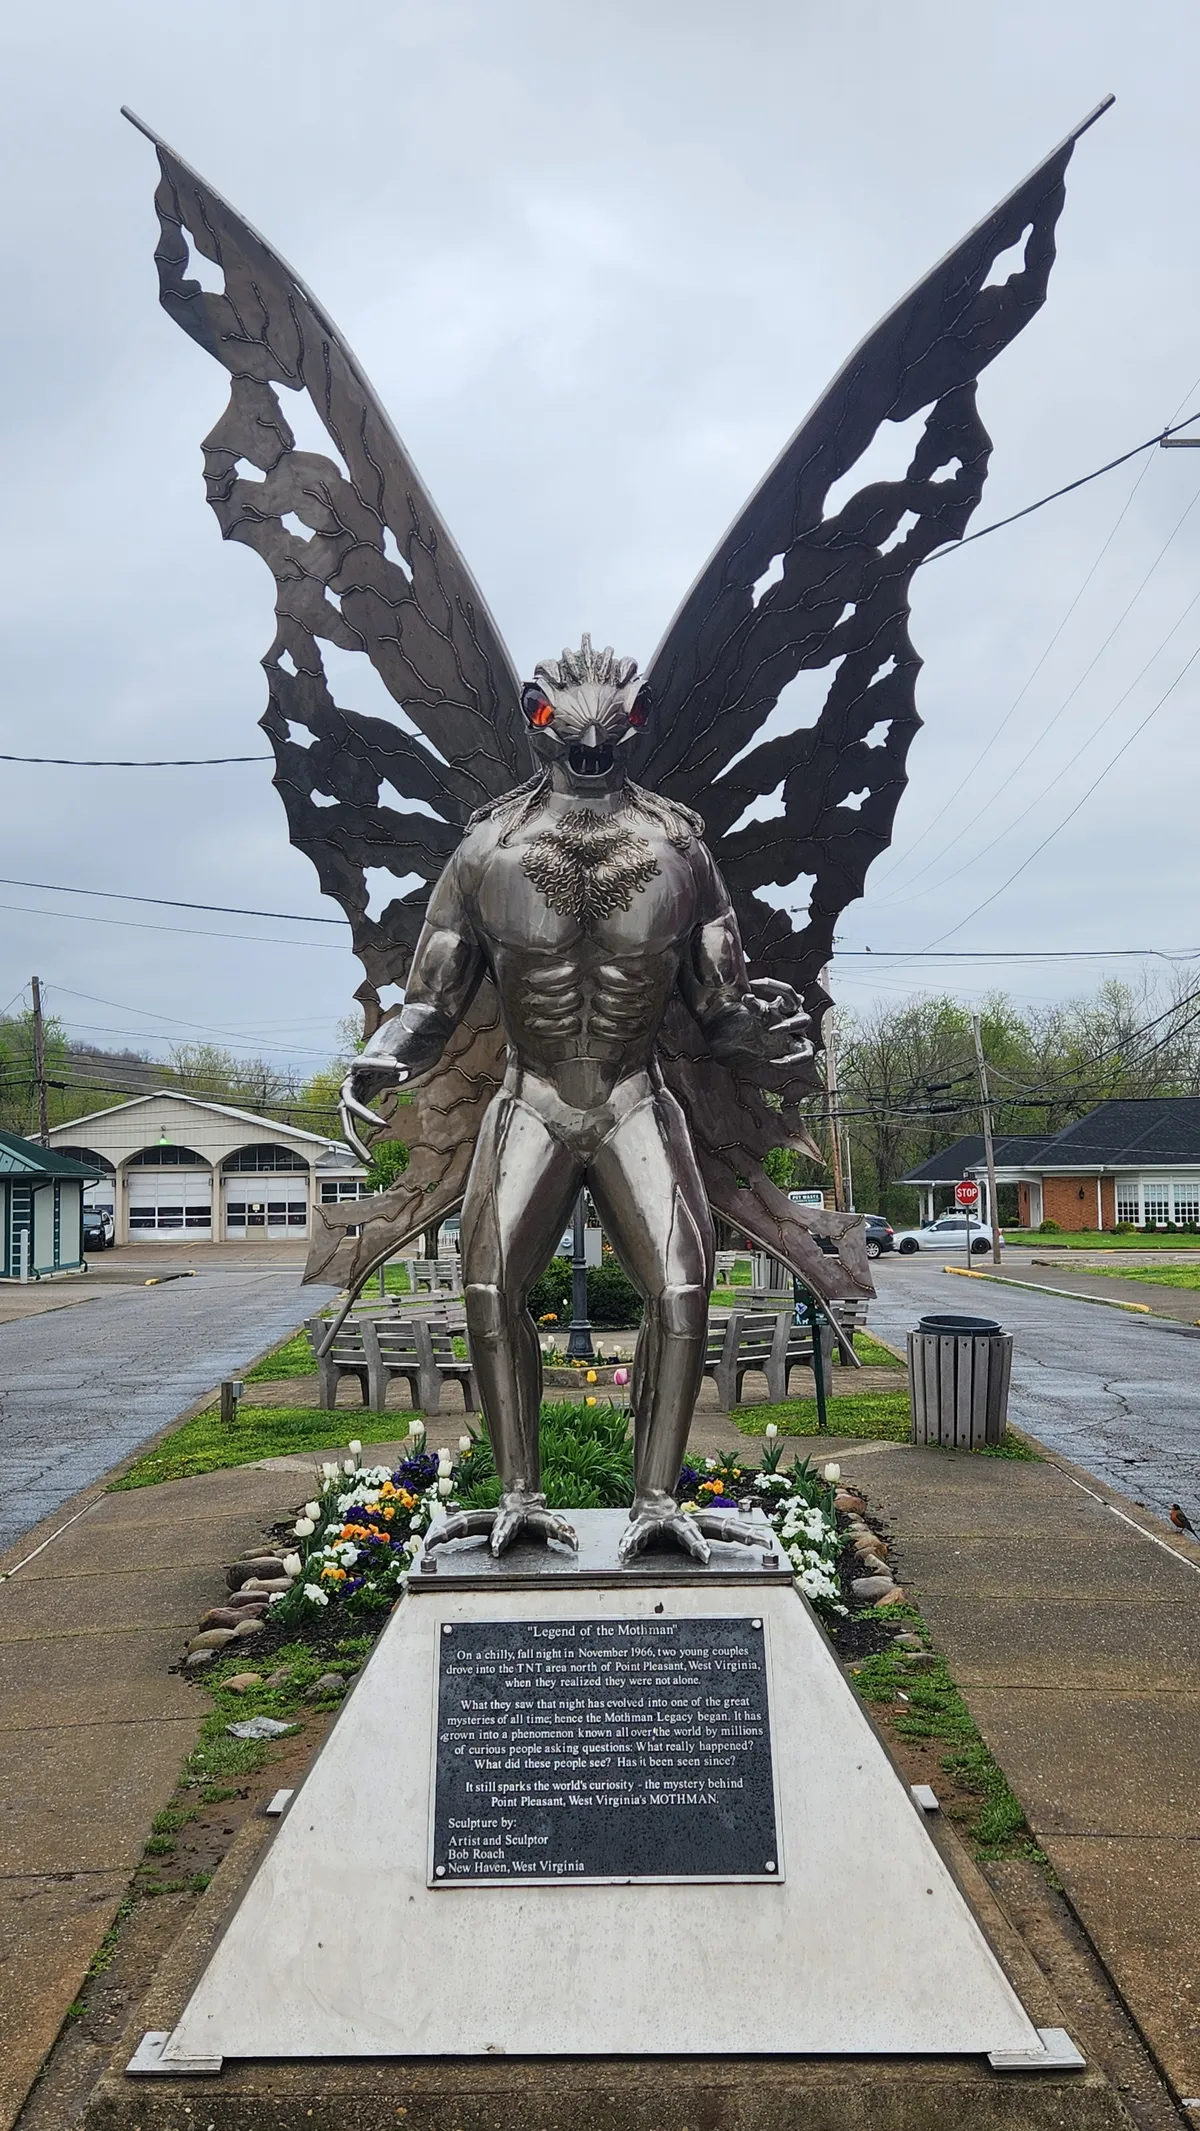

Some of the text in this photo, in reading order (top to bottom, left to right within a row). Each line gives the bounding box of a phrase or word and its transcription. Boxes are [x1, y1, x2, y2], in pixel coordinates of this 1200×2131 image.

[957, 1188, 977, 1197] STOP
[528, 1626, 575, 1638] "Legend
[580, 1626, 591, 1636] of
[597, 1626, 614, 1636] the
[457, 1651, 472, 1660] On
[485, 1649, 515, 1661] chilly,
[517, 1649, 533, 1659] fall
[536, 1649, 562, 1660] night
[564, 1648, 574, 1657] in
[579, 1647, 628, 1658] November
[631, 1647, 655, 1657] 1966,
[658, 1648, 676, 1656] two
[680, 1648, 709, 1659] young
[712, 1646, 749, 1658] couples
[446, 1664, 473, 1674] drove
[476, 1664, 495, 1674] into
[499, 1664, 514, 1673] the
[517, 1663, 543, 1673] TNT
[571, 1663, 597, 1671] north
[601, 1662, 612, 1671] of
[616, 1662, 640, 1671] Point
[643, 1661, 687, 1671] Pleasant,
[688, 1661, 711, 1670] West
[715, 1660, 761, 1671] Virginia,
[505, 1678, 531, 1687] when
[535, 1678, 556, 1689] they
[560, 1676, 601, 1686] realized
[605, 1676, 626, 1687] they
[656, 1677, 670, 1685] not
[673, 1675, 701, 1685] alone.
[461, 1700, 488, 1710] What
[491, 1700, 511, 1711] they
[537, 1699, 556, 1709] that
[559, 1699, 585, 1710] night
[588, 1699, 605, 1708] has
[607, 1698, 643, 1707] evolved
[648, 1698, 667, 1707] into
[671, 1699, 688, 1707] one
[691, 1697, 702, 1706] of
[706, 1697, 721, 1706] the
[724, 1698, 749, 1708] great
[448, 1715, 495, 1727] mysteries
[498, 1714, 508, 1724] of
[510, 1714, 523, 1724] all
[554, 1714, 583, 1723] hence
[586, 1713, 602, 1723] the
[605, 1712, 653, 1722] Mothman
[657, 1712, 693, 1723] Legacy
[698, 1712, 730, 1723] began.
[735, 1711, 742, 1720] It
[745, 1711, 761, 1720] has
[442, 1732, 475, 1742] grown
[479, 1730, 499, 1739] into
[511, 1729, 574, 1741] phenomenon
[578, 1728, 612, 1737] known
[616, 1727, 628, 1736] all
[655, 1727, 670, 1736] the
[674, 1726, 701, 1735] world
[706, 1726, 718, 1737] by
[721, 1725, 763, 1735] millions
[455, 1740, 754, 1756] of curious people asking questions: What really happened?
[475, 1755, 735, 1770] What did these people see? Has it been seen since?
[466, 1782, 473, 1792] It
[475, 1782, 495, 1792] still
[498, 1781, 532, 1794] sparks
[534, 1781, 549, 1791] the
[552, 1780, 587, 1790] world's
[590, 1779, 634, 1791] curiosity
[645, 1779, 660, 1789] the
[664, 1780, 705, 1791] mystery
[708, 1778, 743, 1788] behind
[491, 1797, 517, 1807] Point
[521, 1797, 566, 1807] Pleasant,
[569, 1796, 593, 1805] West
[596, 1795, 646, 1807] Virginia's
[448, 1817, 517, 1830] Sculpture by:
[448, 1835, 548, 1847] Artist and Sculptor
[448, 1849, 505, 1859] Bob Roach
[448, 1860, 584, 1874] New Haven, West Virginia
